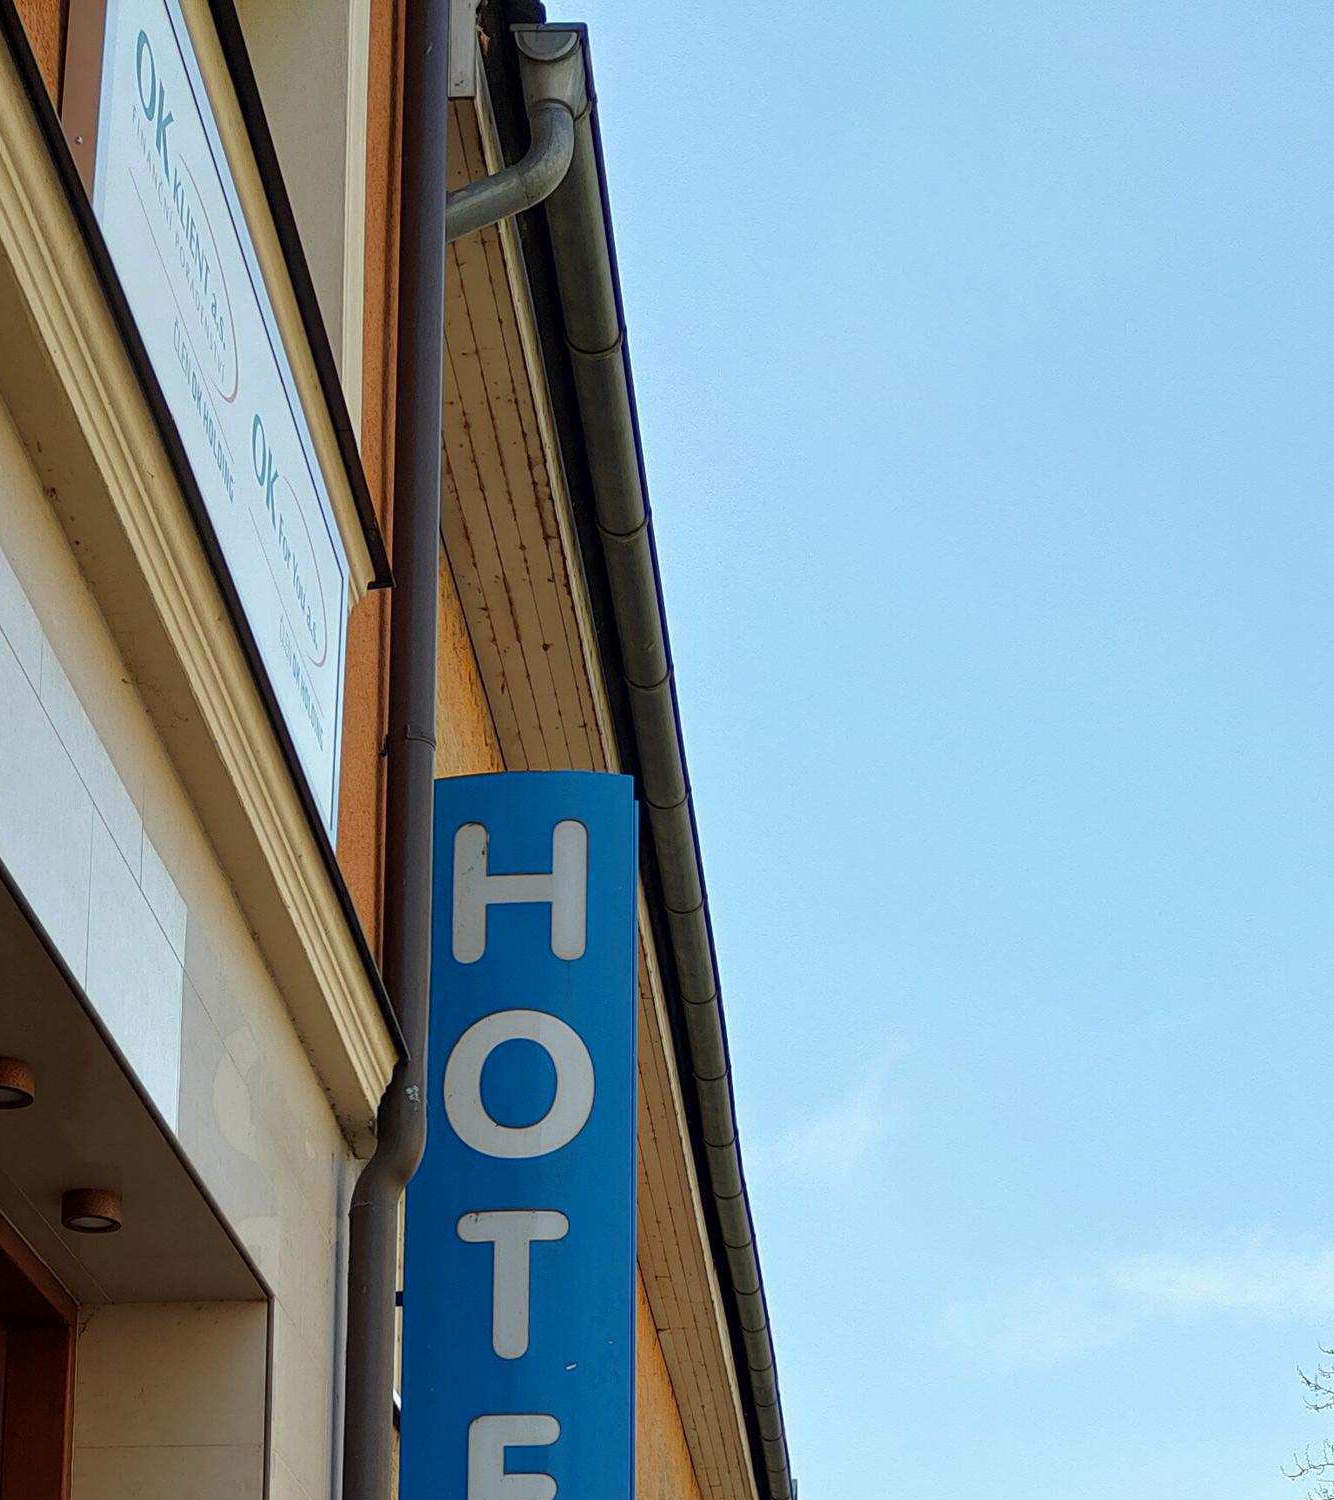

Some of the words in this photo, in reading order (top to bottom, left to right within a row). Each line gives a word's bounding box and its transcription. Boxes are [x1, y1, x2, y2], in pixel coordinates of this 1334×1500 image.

[136, 28, 175, 185] OK
[173, 166, 211, 296] KLIENT
[210, 292, 226, 351] a.s.
[202, 401, 236, 504] HOLDING
[251, 413, 280, 530] OK
[278, 512, 292, 569] For
[291, 552, 307, 614] You
[300, 673, 324, 752] HOLDING
